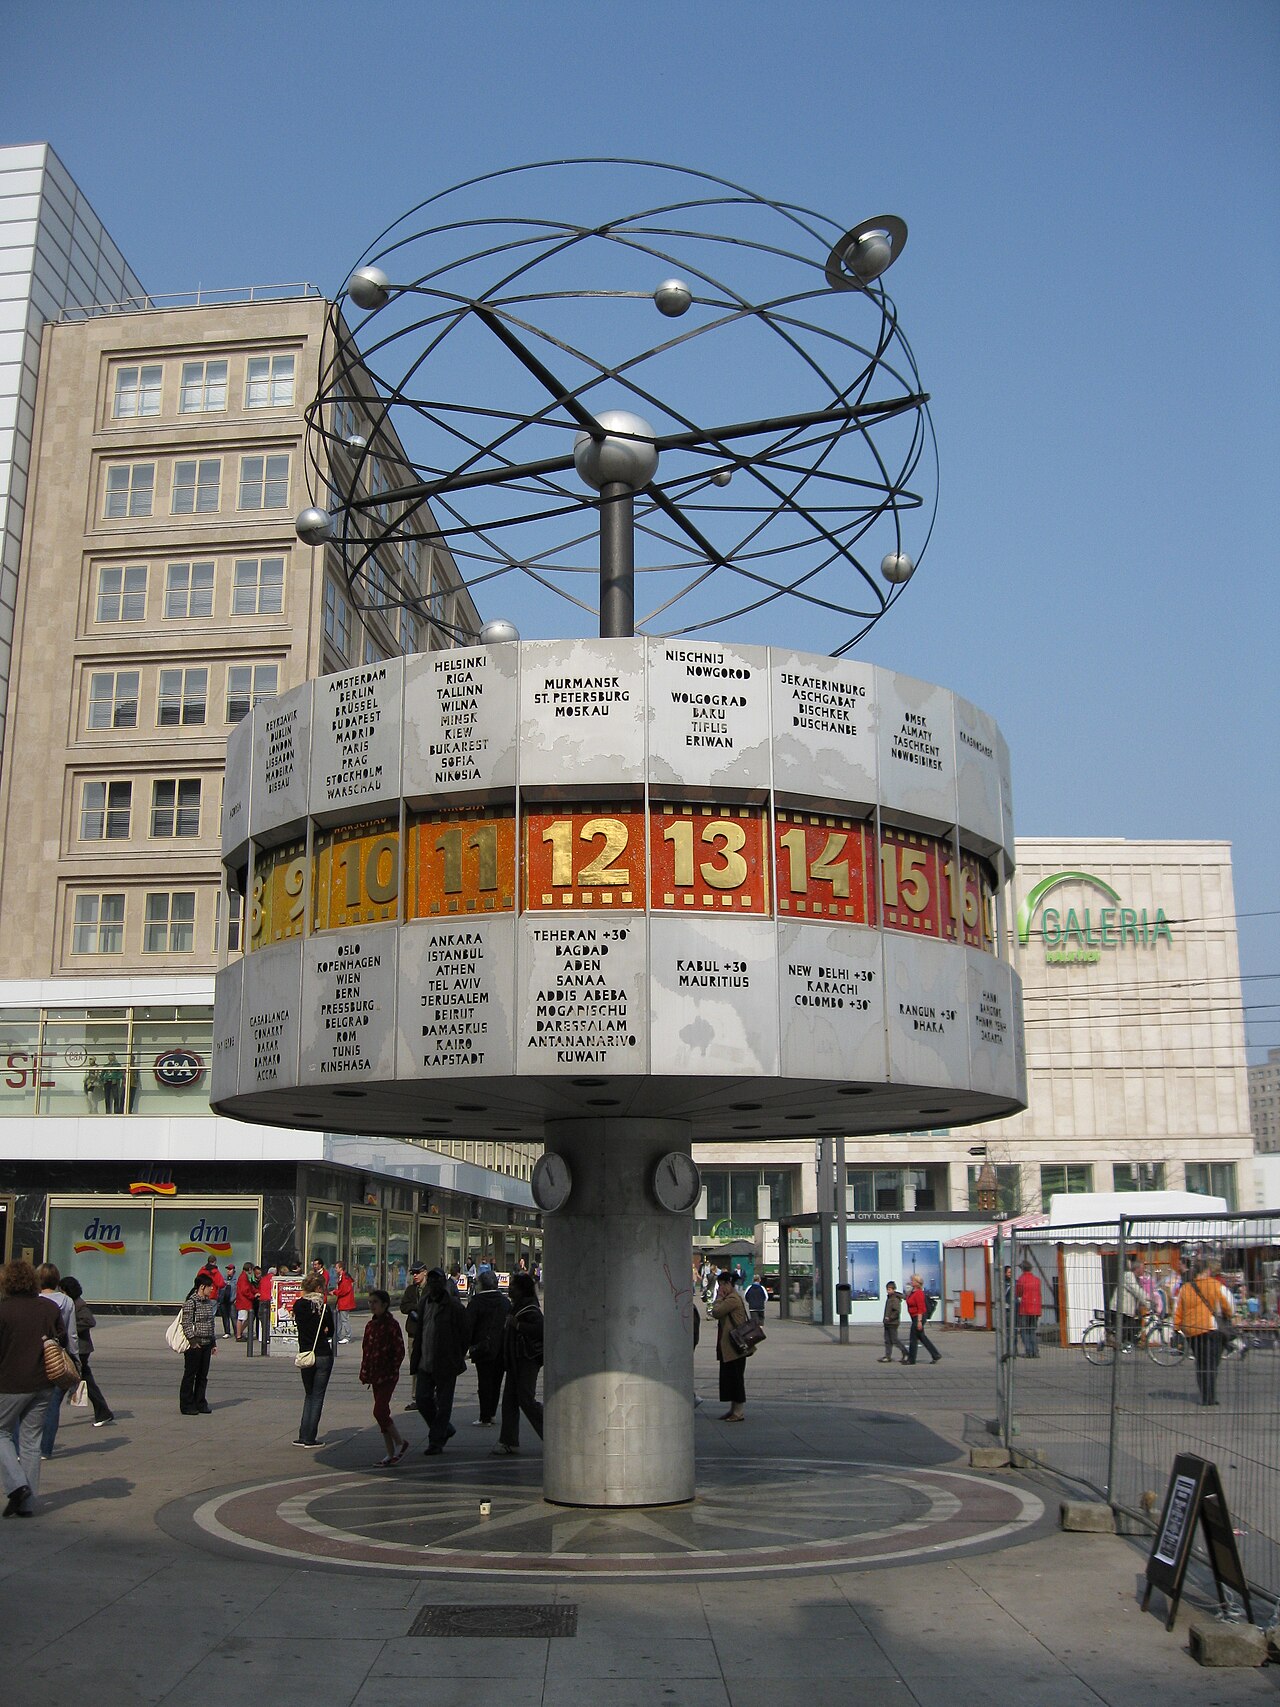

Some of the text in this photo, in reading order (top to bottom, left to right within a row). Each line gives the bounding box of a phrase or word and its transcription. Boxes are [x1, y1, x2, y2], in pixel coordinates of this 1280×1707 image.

[435, 656, 486, 672] HELSINKI
[666, 650, 723, 664] NISCHNIJ
[446, 672, 473, 684] RIGA
[686, 666, 750, 680] NOWGOROD
[329, 669, 386, 692] AMSTERDAM
[545, 677, 619, 689] MURMANSK
[781, 673, 866, 697] JEKATERINBURG
[340, 686, 374, 702] BERLIN
[437, 684, 483, 700] TALLINN
[535, 691, 630, 703] ST. PETERSBURG
[441, 699, 478, 712] WILNA
[672, 692, 747, 707] WOLGOGRAD
[792, 690, 856, 709] ASCHGABAT
[335, 698, 378, 717] BRÜSSEL
[555, 706, 609, 717] MOSKAU
[693, 708, 725, 719] BAKU
[799, 703, 850, 721] BISCHKEK
[266, 710, 298, 732] REYKJAVIK
[332, 711, 381, 731] BUDAPEST
[441, 712, 478, 727] MINSK
[793, 716, 857, 736] DUSCHANBE
[905, 712, 927, 727] OMSK
[271, 725, 292, 742] DUBLIN
[445, 726, 473, 740] KIEW
[691, 721, 728, 733] TIFLIS
[901, 725, 932, 741] ALMATY
[336, 727, 375, 743] MADRID
[269, 738, 292, 755] LONDON
[342, 741, 368, 756] PARIS
[429, 739, 488, 756] BUKAREST
[686, 736, 733, 749] ERIWAN
[894, 735, 939, 757] TASCHKENT
[266, 750, 295, 769] LISSABON
[342, 754, 367, 769] PRAG
[441, 755, 475, 768] SOFIA
[891, 748, 943, 771] NOWOSIBIRSK
[266, 763, 293, 782] MADEIRA
[326, 766, 382, 787] STOCKHOLM
[435, 769, 481, 783] NIKOSIA
[269, 777, 289, 793] BISSAU
[327, 782, 381, 800] WARSCHAU
[286, 856, 306, 922] 9
[338, 837, 399, 908] 10
[435, 823, 497, 894] 11
[541, 818, 631, 888] 12
[664, 820, 748, 890] 13
[780, 826, 850, 898] 14
[882, 842, 931, 912] 15
[944, 860, 978, 928] 16
[1042, 908, 1173, 944] GALERIA
[430, 933, 482, 947] ANKARA
[534, 930, 596, 941] TEHERAN
[338, 944, 360, 956] OSLO
[428, 947, 484, 962] ISTANBUL
[556, 944, 608, 956] BAGDAD
[317, 956, 381, 973] KOPENHAGEN
[436, 963, 475, 976] ATHEN
[564, 960, 600, 971] ADEN
[677, 960, 747, 972] KABUL +30
[336, 972, 361, 985] WIEN
[789, 965, 812, 976] NEW
[819, 967, 849, 980] DELHI
[429, 977, 481, 991] TEL AVIV
[557, 975, 606, 986] SANAA
[679, 976, 749, 987] MAURITIUS
[336, 987, 360, 999] BERN
[808, 981, 858, 995] KARACHI
[421, 992, 489, 1006] JERUSALEM
[536, 990, 627, 1001] ADDIS ABEBA
[795, 995, 843, 1009] COLOMBO
[321, 1000, 374, 1015] PRESSBURG
[434, 1008, 474, 1021] BEIRUT
[900, 1004, 935, 1018] RANGUN
[250, 1010, 289, 1027] CASABLANCA
[326, 1015, 369, 1029] BELGRAD
[255, 1025, 283, 1040] CONAKRY
[422, 1022, 487, 1036] DAMASKUS
[536, 1020, 627, 1032] DARESSALAM
[914, 1020, 945, 1034] DHAKA
[336, 1031, 356, 1042] ROM
[528, 1036, 636, 1047] ANTANANARIVO
[257, 1040, 278, 1053] DAKAR
[333, 1045, 360, 1057] TUNIS
[437, 1038, 472, 1050] KAIRO
[254, 1054, 281, 1068] BAMAKO
[424, 1053, 484, 1066] KAPSTADT
[557, 1051, 606, 1062] KUWAIT
[162, 1060, 192, 1076] C&A
[321, 1059, 371, 1072] KINSHASA
[257, 1069, 277, 1081] ACCRA
[84, 1218, 120, 1241] dm
[190, 1219, 228, 1242] dm
